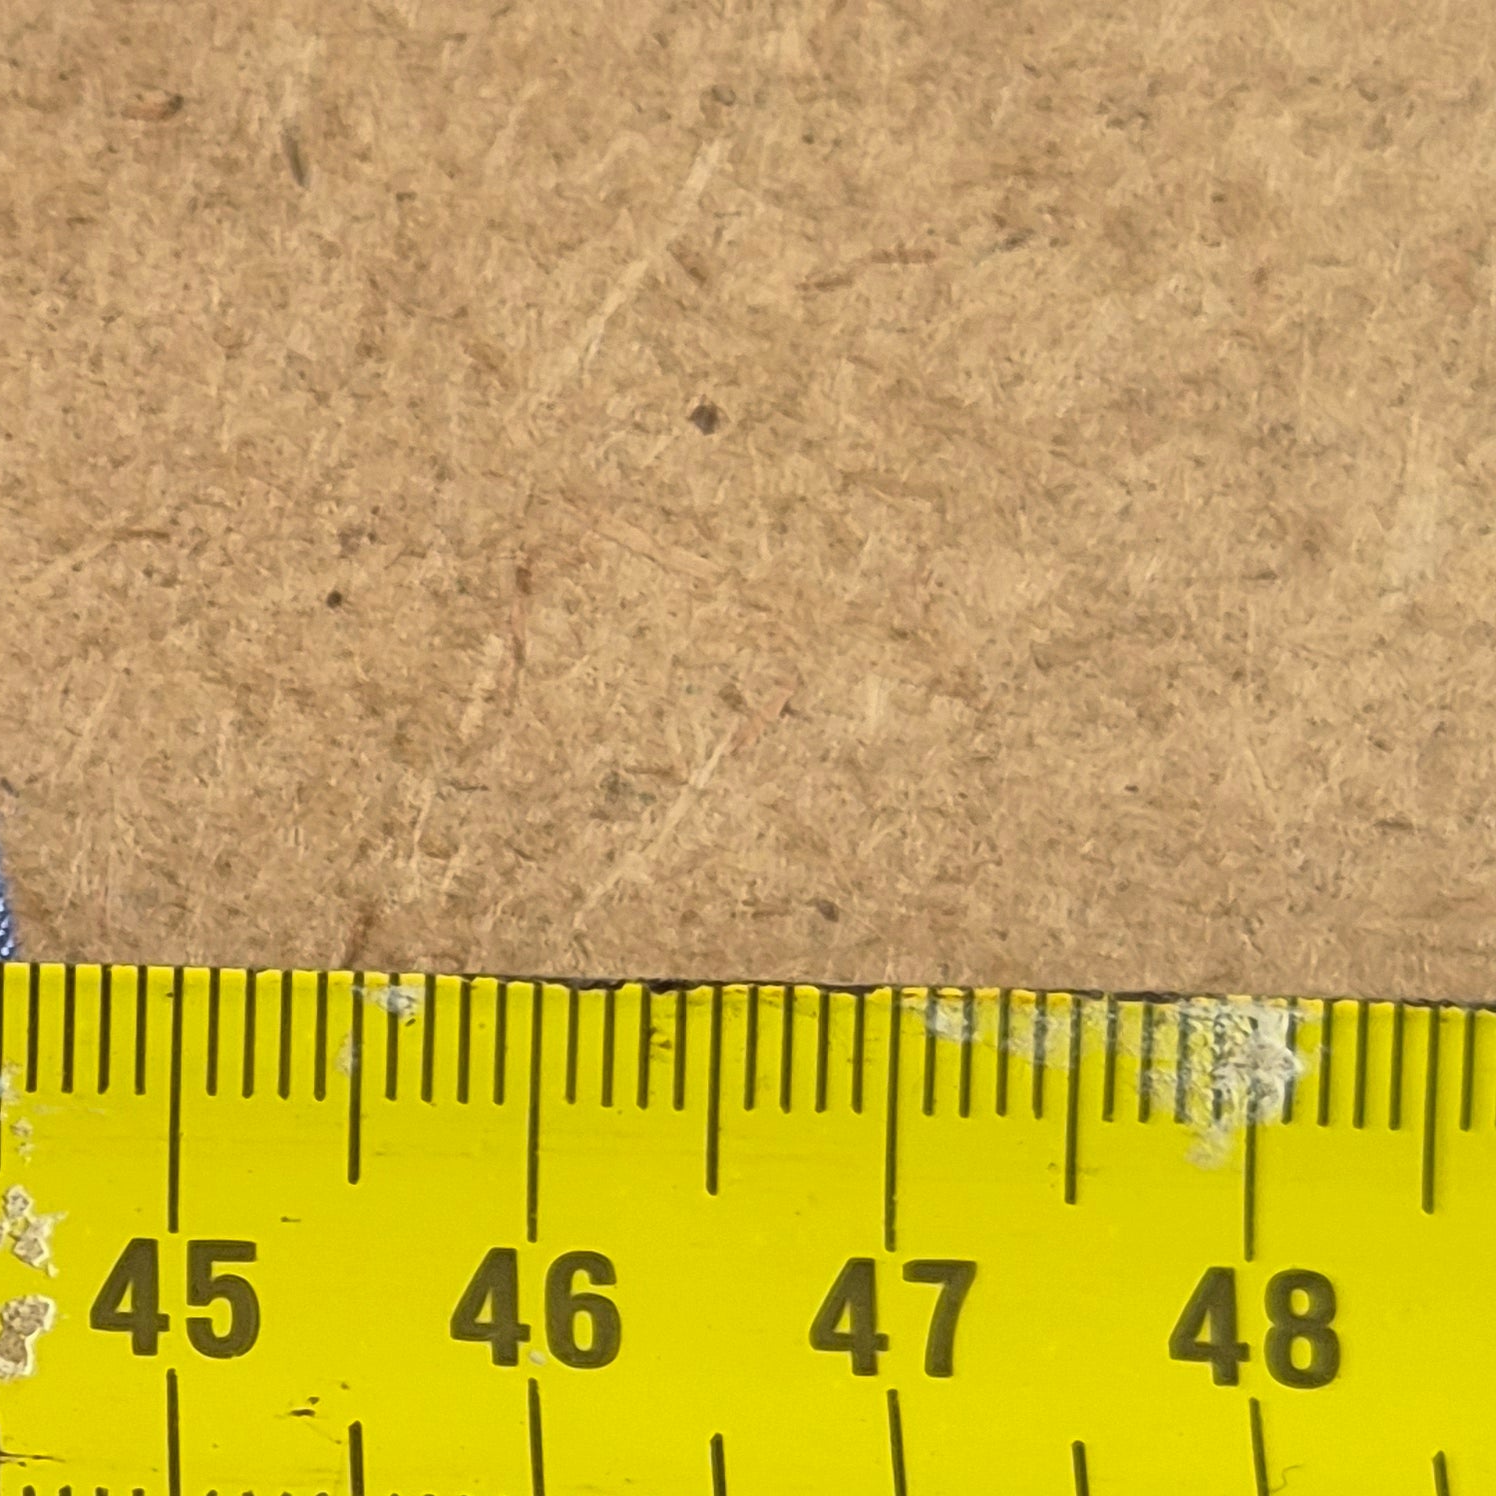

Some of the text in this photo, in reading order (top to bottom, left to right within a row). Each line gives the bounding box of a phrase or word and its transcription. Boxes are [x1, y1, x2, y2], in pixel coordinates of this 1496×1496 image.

[91, 1238, 261, 1360] 45
[451, 1247, 622, 1370] 46
[811, 1258, 976, 1379] 47
[1170, 1267, 1341, 1390] 48
